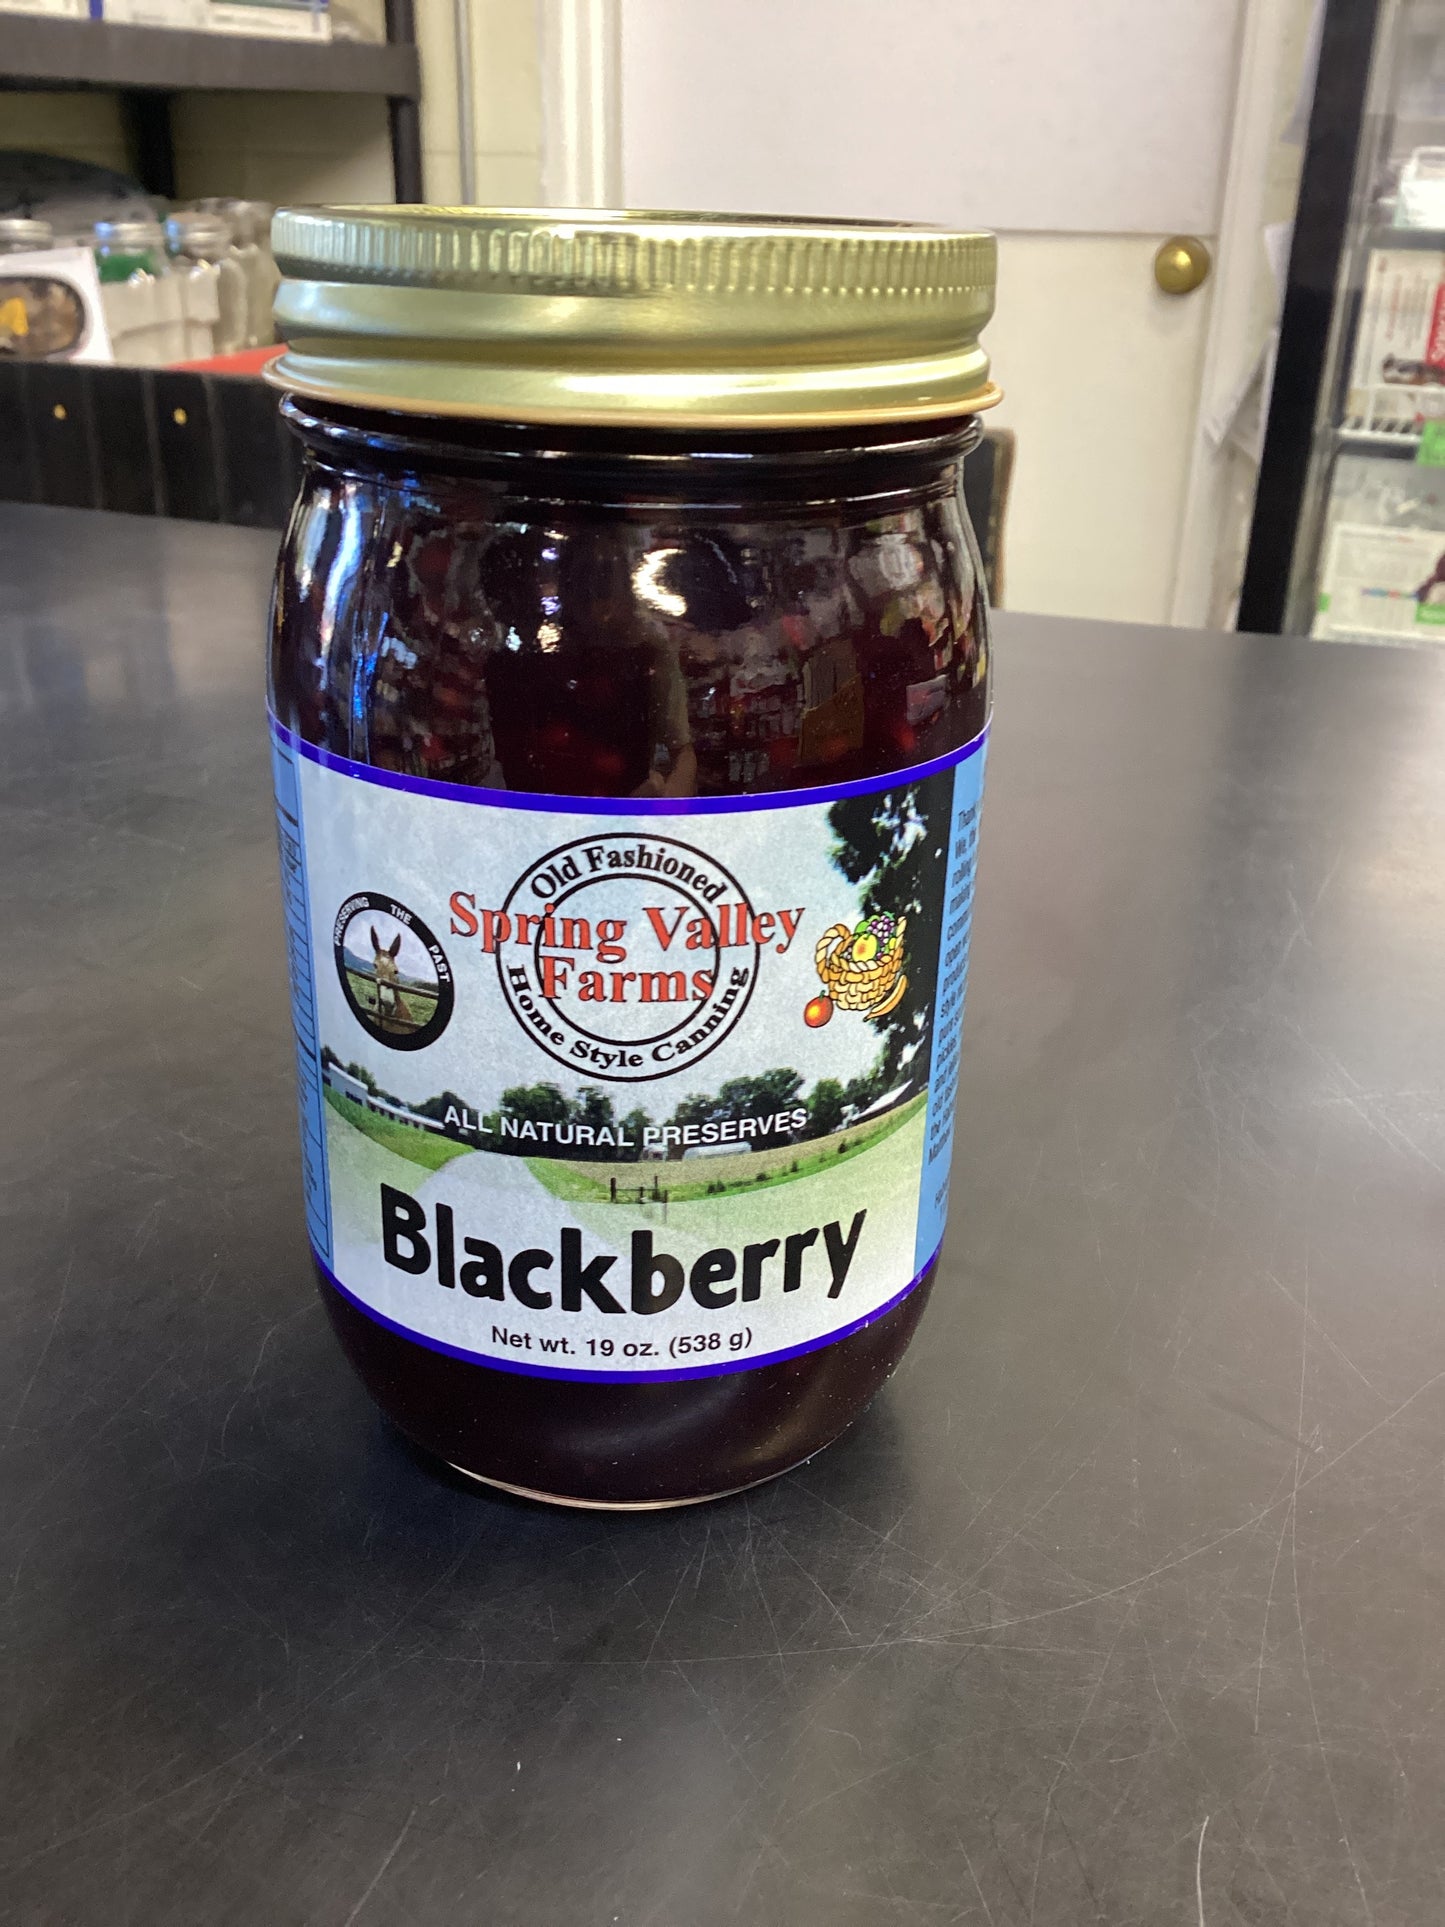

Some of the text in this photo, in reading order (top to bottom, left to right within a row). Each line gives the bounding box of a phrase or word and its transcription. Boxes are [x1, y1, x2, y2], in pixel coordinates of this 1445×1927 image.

[531, 844, 727, 904] Old Fashioned
[334, 897, 450, 983] PRESERVING THE PAST
[449, 891, 805, 963] Spring Valley
[538, 955, 715, 1003] Farms
[506, 964, 749, 1069] Home Style Canning
[443, 1105, 808, 1148] ALL NATURAL PRESERVES
[380, 1182, 868, 1315] Blackberry
[492, 1326, 754, 1359] Net wt. 19 oz. (538 g)
